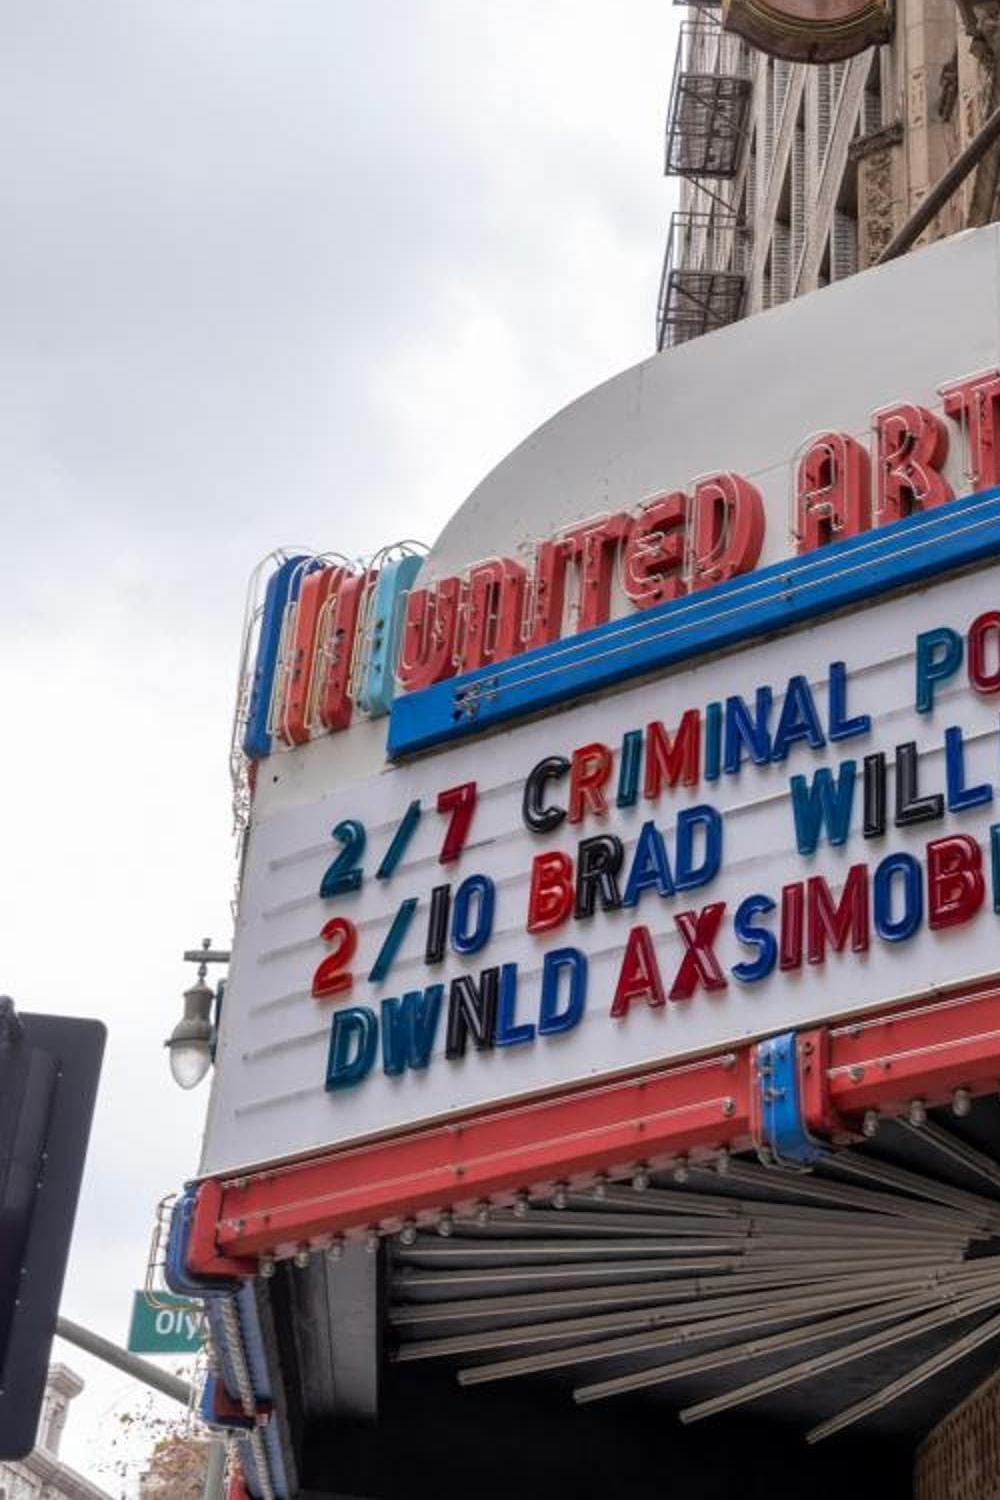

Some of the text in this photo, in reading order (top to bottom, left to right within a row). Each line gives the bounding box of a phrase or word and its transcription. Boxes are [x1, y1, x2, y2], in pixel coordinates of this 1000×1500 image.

[395, 469, 766, 692] UNITED
[320, 781, 477, 900] 2/7
[522, 661, 872, 834] CRIMINAL
[311, 874, 496, 998] 2/10
[527, 804, 723, 934] BRAD
[325, 947, 588, 1092] DWNLD
